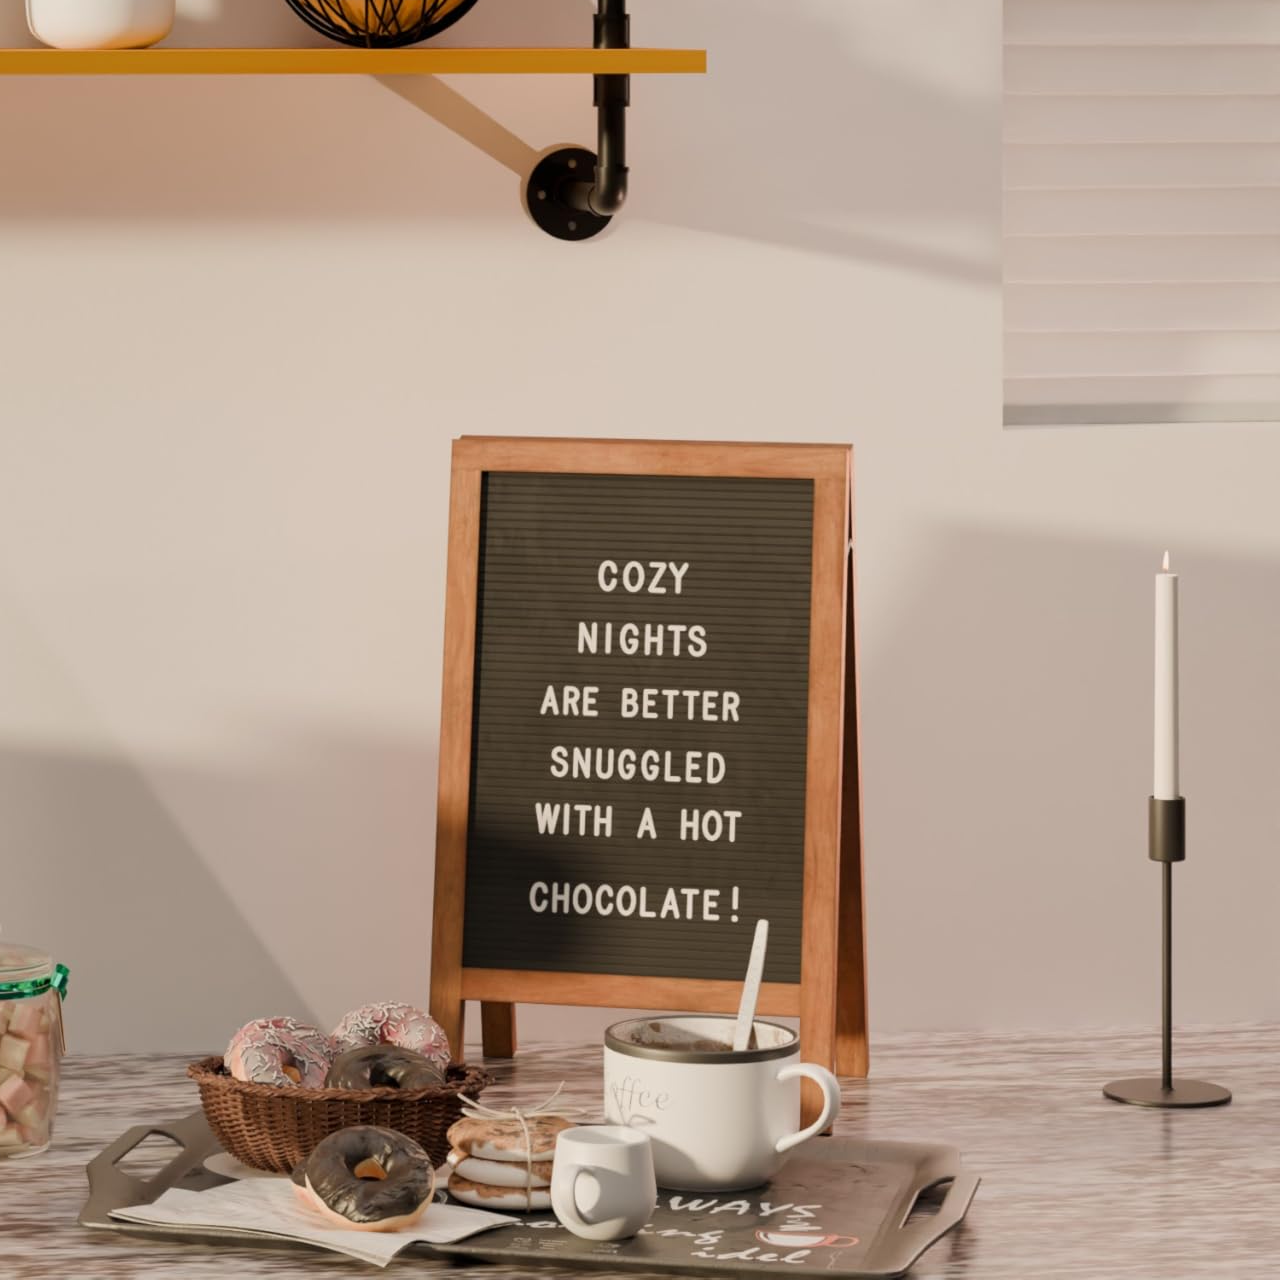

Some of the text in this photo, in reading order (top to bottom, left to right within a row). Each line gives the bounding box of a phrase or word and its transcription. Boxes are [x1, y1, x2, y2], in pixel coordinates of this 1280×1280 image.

[597, 560, 690, 595] COZY
[577, 621, 708, 658] NIGHTS
[540, 685, 741, 722] ARE BETTER
[550, 745, 726, 785] SNUGGLED
[535, 802, 742, 843] WITH A HOT
[529, 880, 740, 923] CHOCOLATE!
[655, 1195, 822, 1219] WAYS
